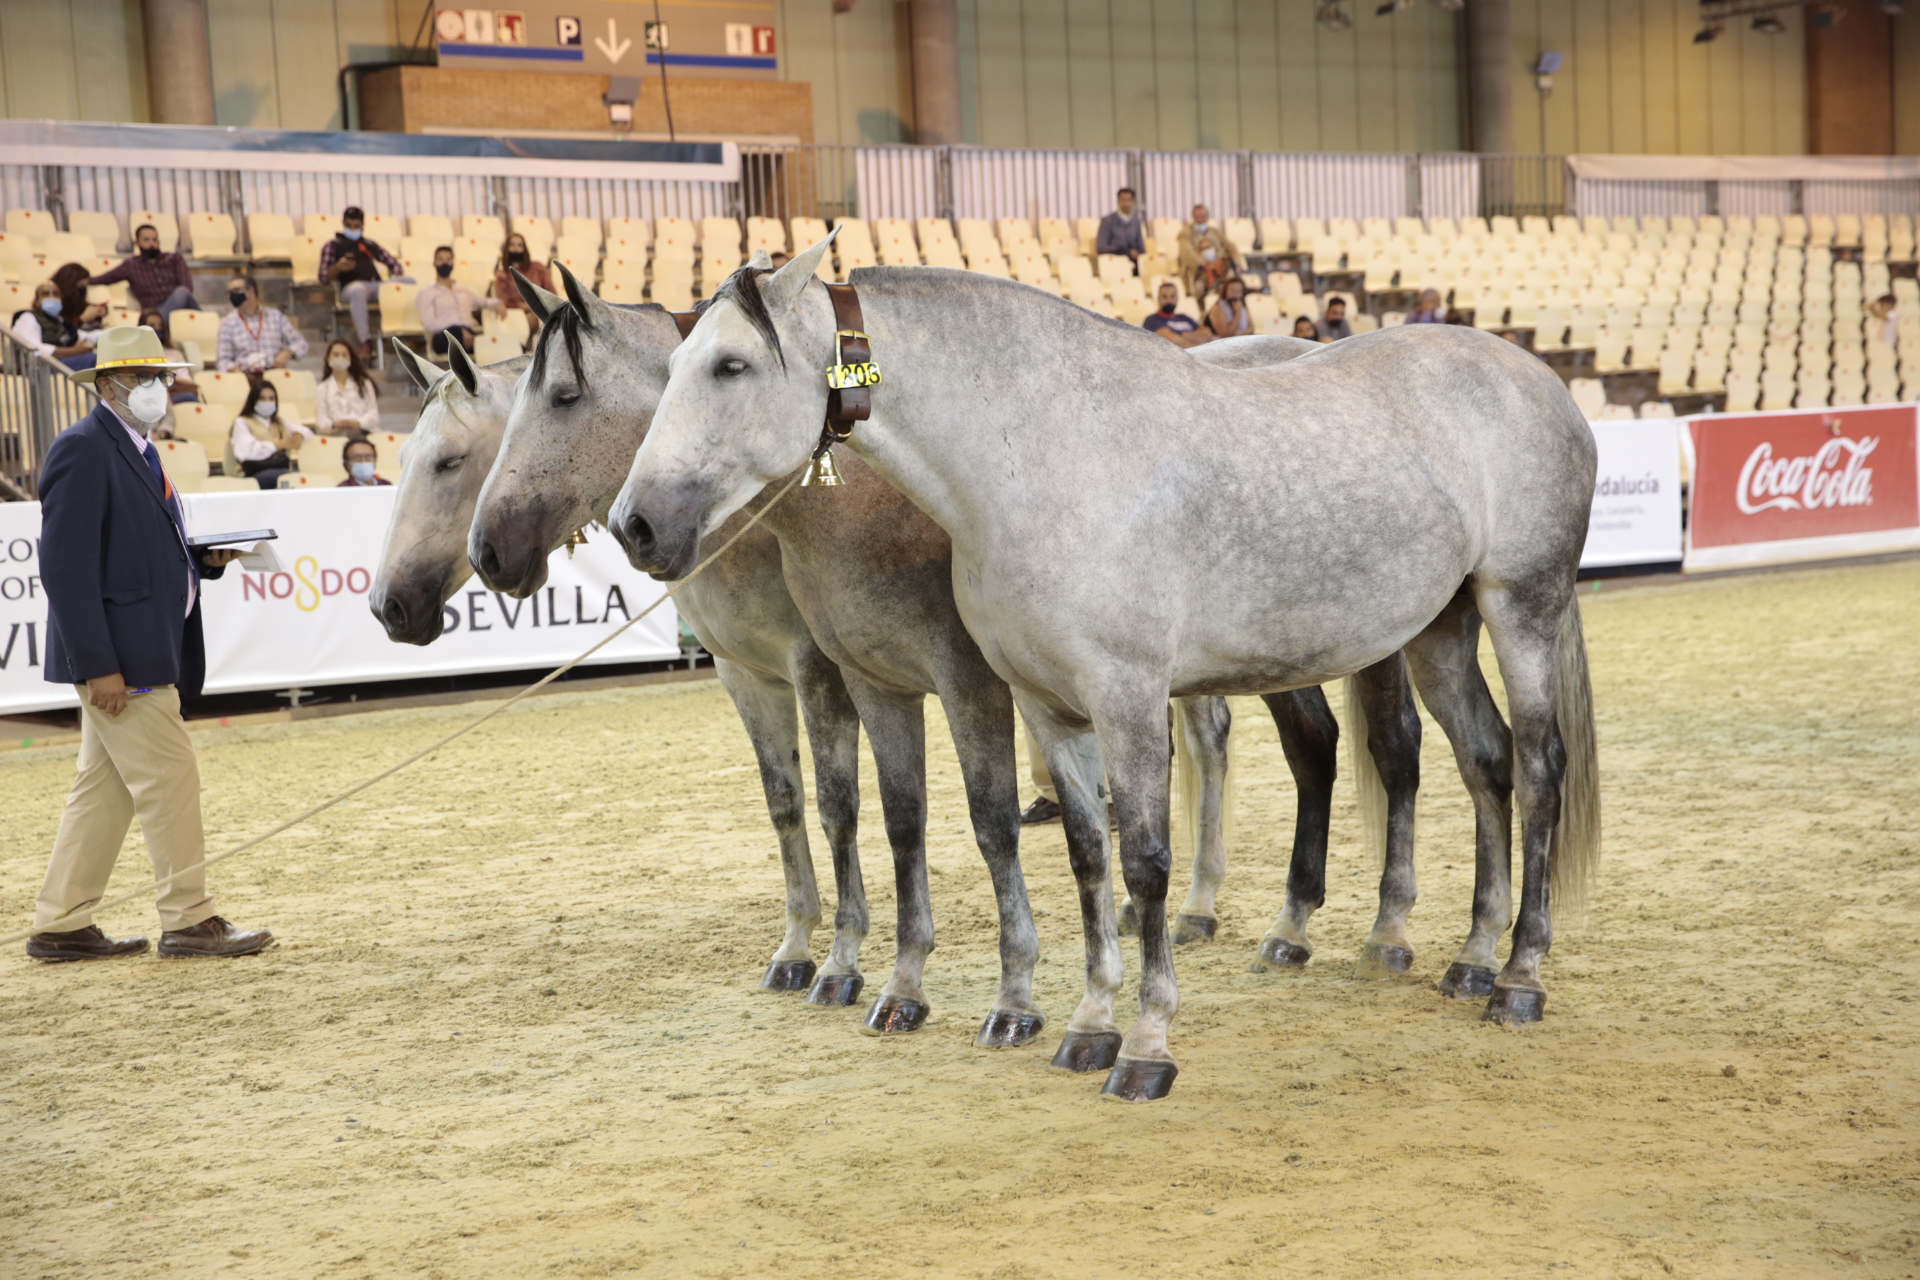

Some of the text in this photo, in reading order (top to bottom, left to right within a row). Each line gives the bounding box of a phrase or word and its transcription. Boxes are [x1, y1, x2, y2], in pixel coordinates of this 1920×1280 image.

[558, 17, 578, 44] P
[827, 363, 880, 388] 1303
[1736, 435, 1881, 516] Coca-Cola
